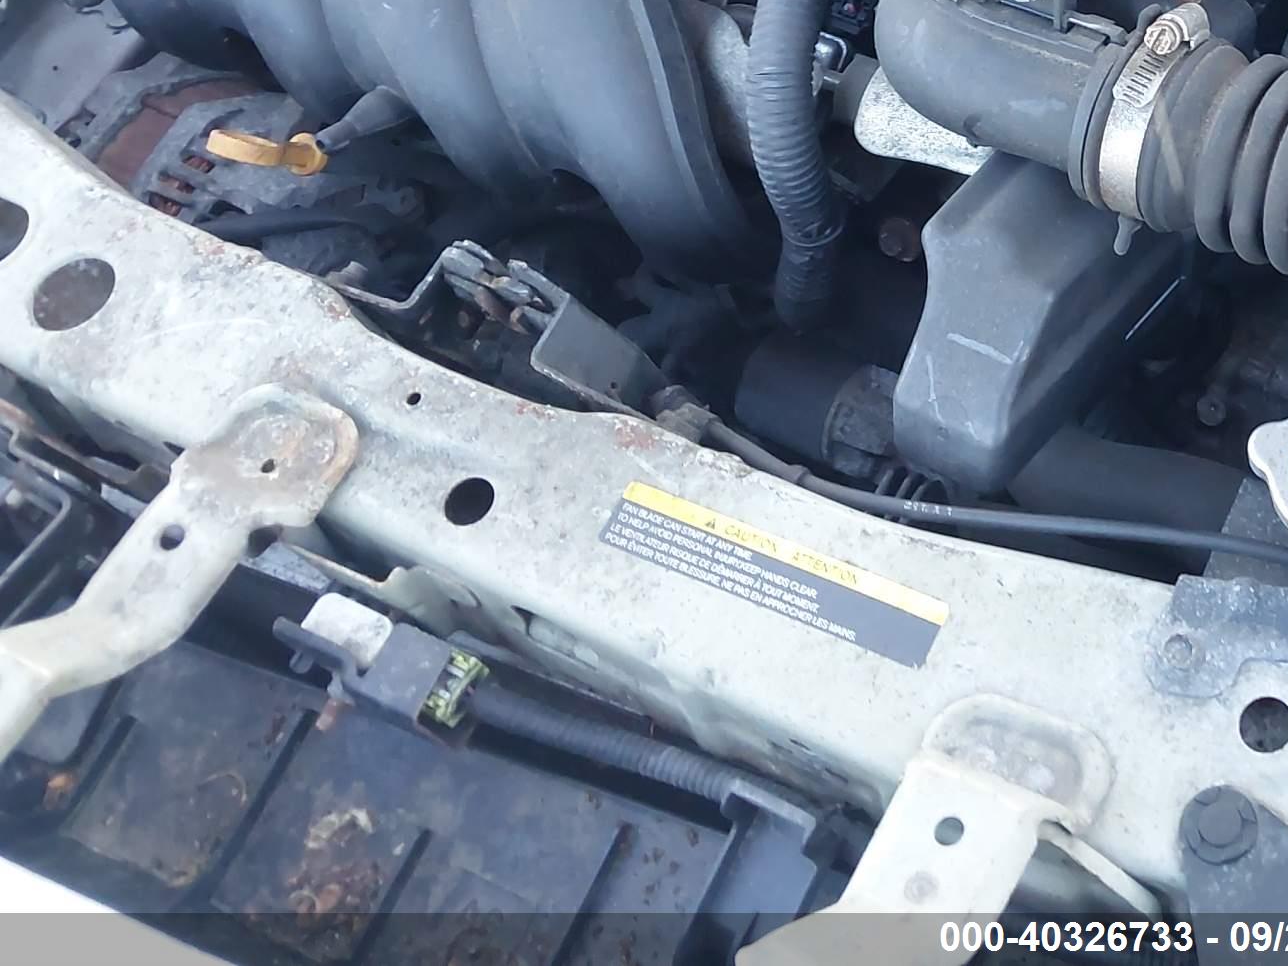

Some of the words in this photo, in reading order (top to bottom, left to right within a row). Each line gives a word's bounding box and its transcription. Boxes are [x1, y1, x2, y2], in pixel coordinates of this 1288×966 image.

[610, 522, 621, 532] LE
[621, 527, 669, 552] VENTILATEUR
[669, 546, 700, 565] RISQUE
[699, 559, 712, 569] DE
[761, 583, 782, 597] TOUT
[617, 512, 628, 522] TO
[628, 516, 649, 530] HELP
[649, 525, 672, 540] AVOID
[672, 534, 713, 556] PERSONAL
[760, 570, 788, 586] HANDS
[623, 502, 639, 514] FAN
[638, 509, 663, 524] BLADE
[663, 519, 681, 531] CAN
[680, 525, 705, 541] START
[705, 535, 716, 545] AT
[716, 540, 732, 552] ANY
[604, 532, 627, 547] POUR
[653, 552, 679, 568] TOUTE
[720, 579, 734, 590] NE
[733, 584, 749, 597] PAS
[750, 591, 763, 602] EN
[761, 595, 813, 622] APPROCHER
[813, 616, 828, 628] LES
